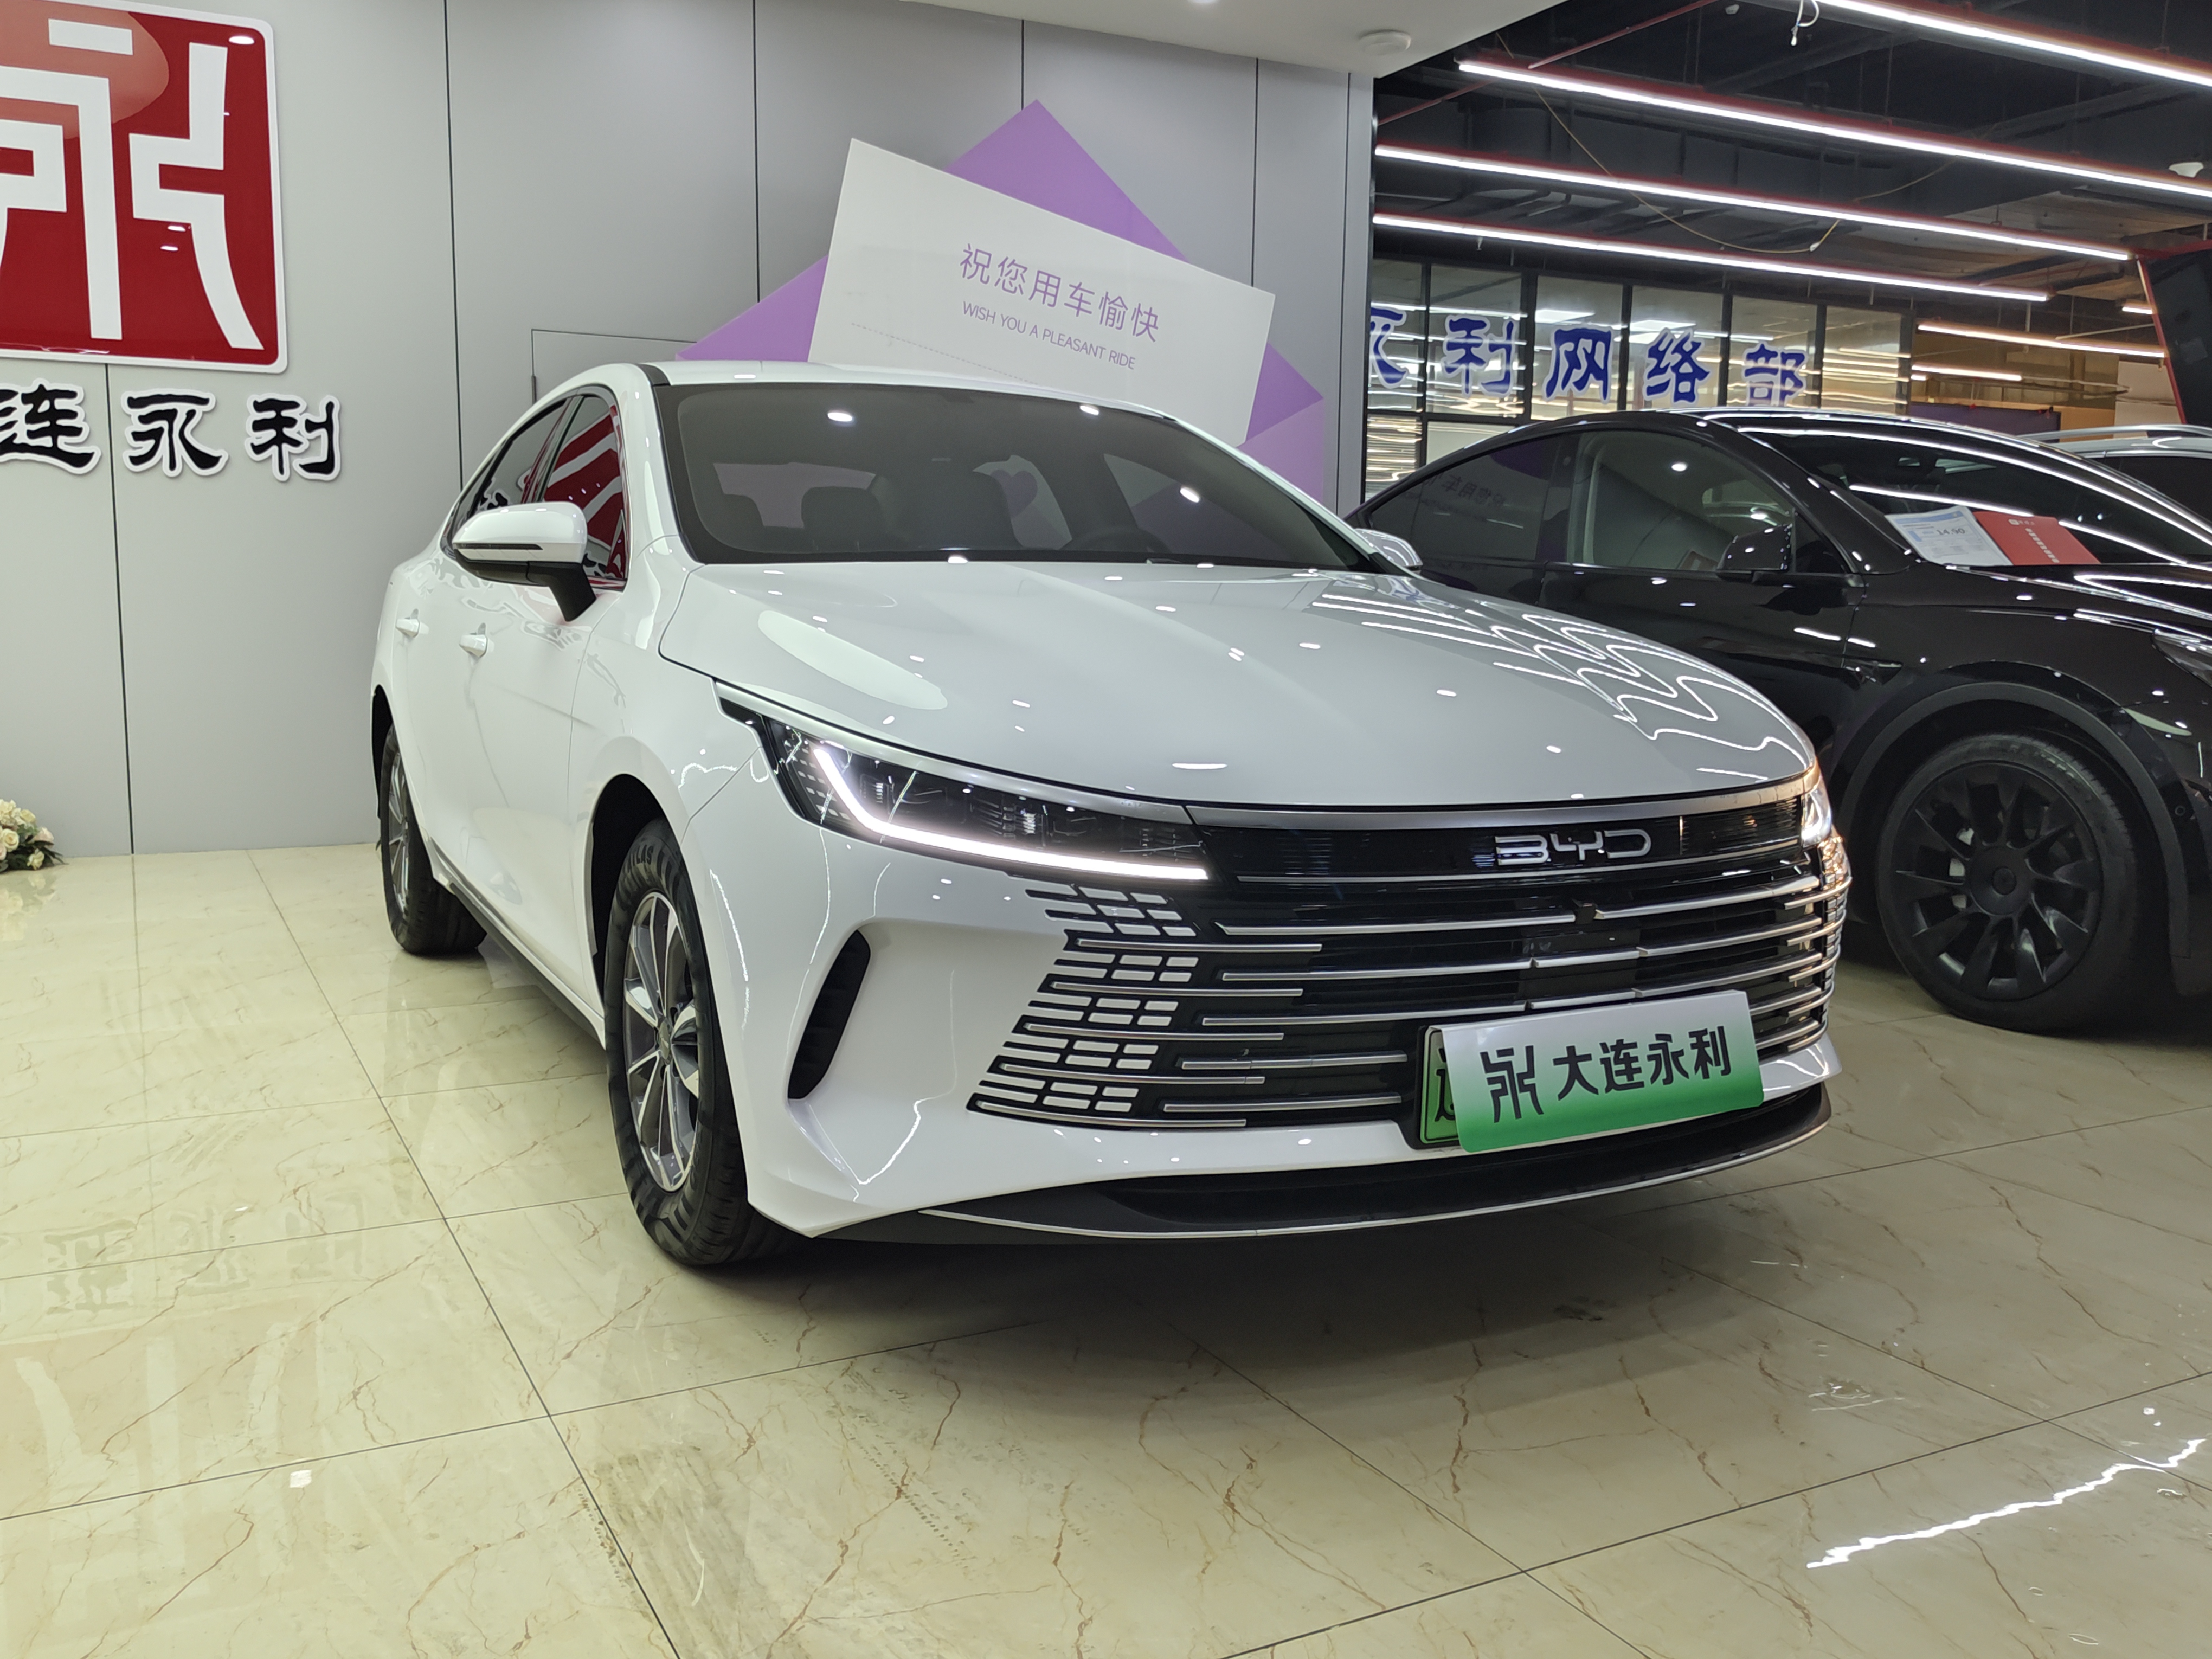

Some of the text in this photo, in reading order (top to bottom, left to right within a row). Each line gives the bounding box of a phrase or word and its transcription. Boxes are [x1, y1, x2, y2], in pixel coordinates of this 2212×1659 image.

[960, 243, 1159, 343] 祝您用车愉快
[962, 300, 1136, 370] WISH YOU A PLEASANT RIDE
[0, 383, 336, 477] 连永利
[1494, 828, 1652, 866] BYD
[1552, 1025, 1732, 1101] 大连永利
